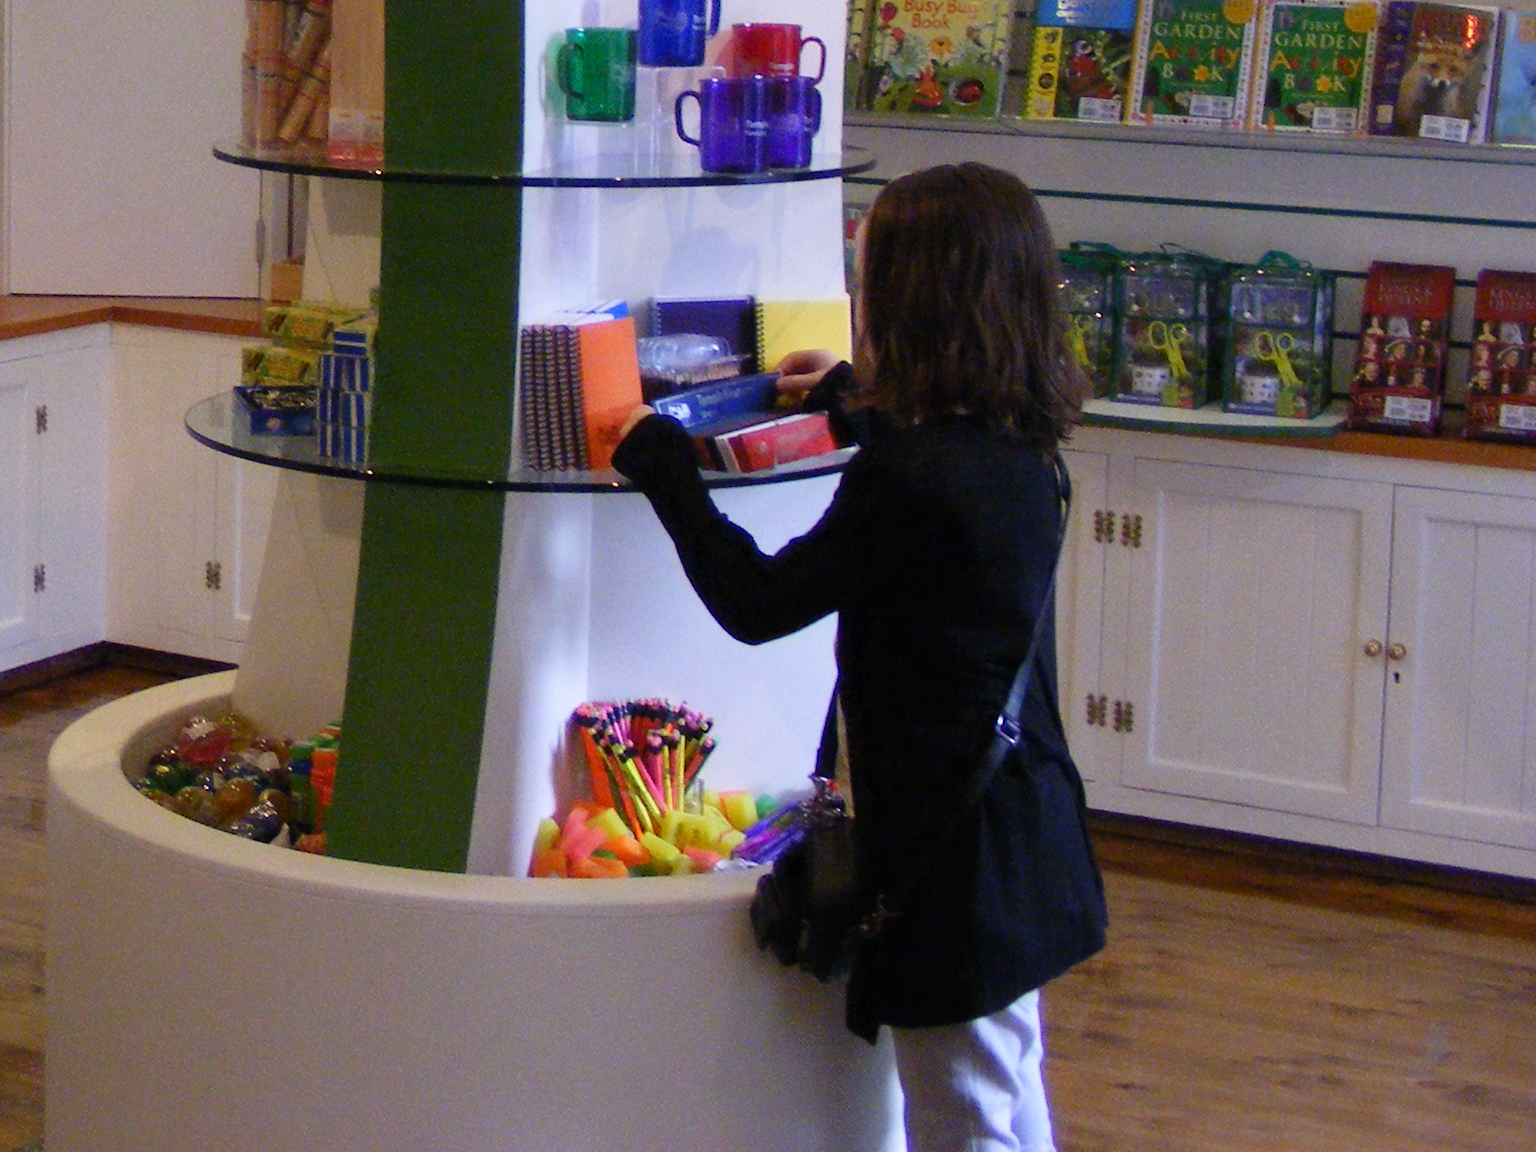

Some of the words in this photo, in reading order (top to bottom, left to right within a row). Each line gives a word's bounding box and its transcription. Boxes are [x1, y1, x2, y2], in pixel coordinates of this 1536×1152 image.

[912, 13, 950, 30] Book
[1181, 10, 1217, 22] FIRST
[1154, 21, 1242, 40] GARDEN
[1302, 19, 1340, 32] FIRST
[1274, 31, 1363, 49] GARDEN
